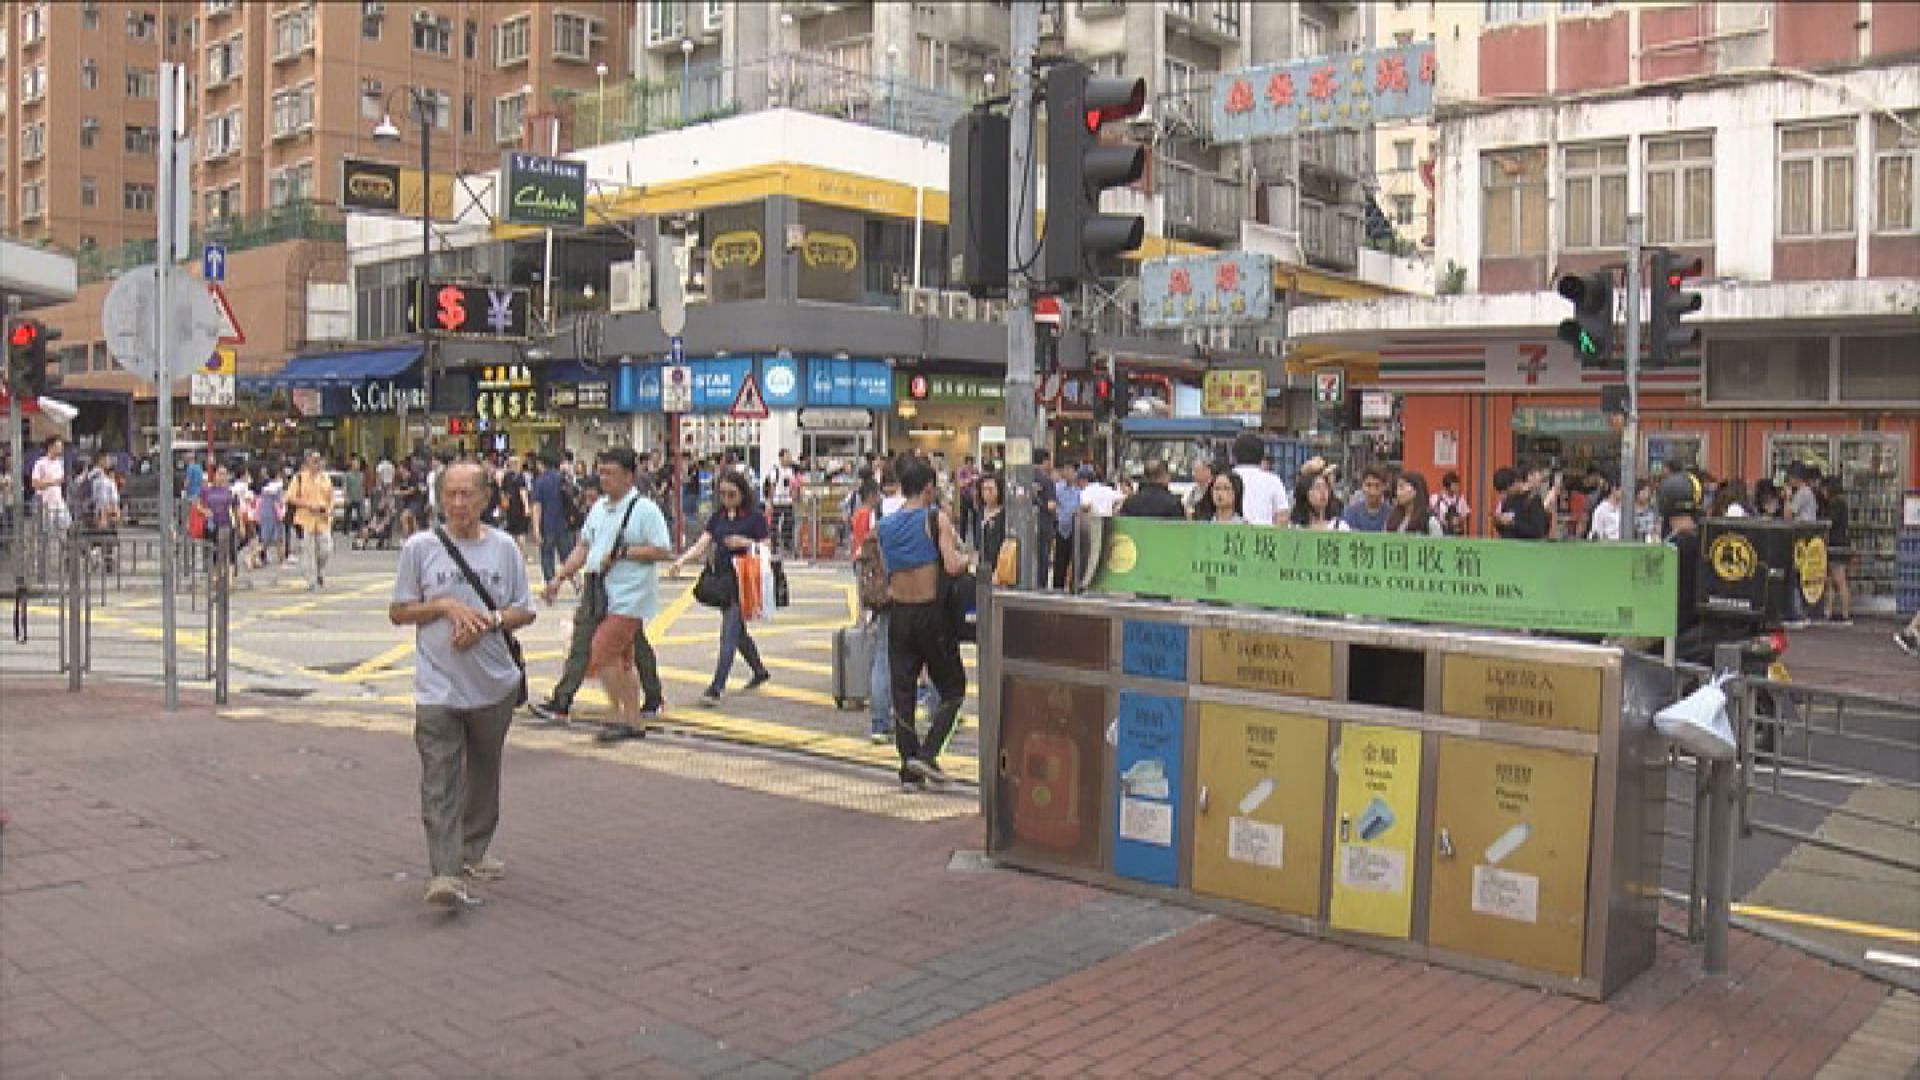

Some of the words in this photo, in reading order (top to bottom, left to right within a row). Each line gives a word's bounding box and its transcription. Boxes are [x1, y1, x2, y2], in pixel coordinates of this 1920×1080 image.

[436, 284, 465, 330] $
[487, 288, 512, 337] ¥
[1223, 531, 1279, 562] 垃圾
[1316, 538, 1481, 578] 廢物回收箱
[1191, 560, 1238, 577] LITTER
[1280, 568, 1382, 588] RECYCLABLES
[1386, 575, 1489, 596] COLLECTION
[1495, 583, 1524, 599] BIN
